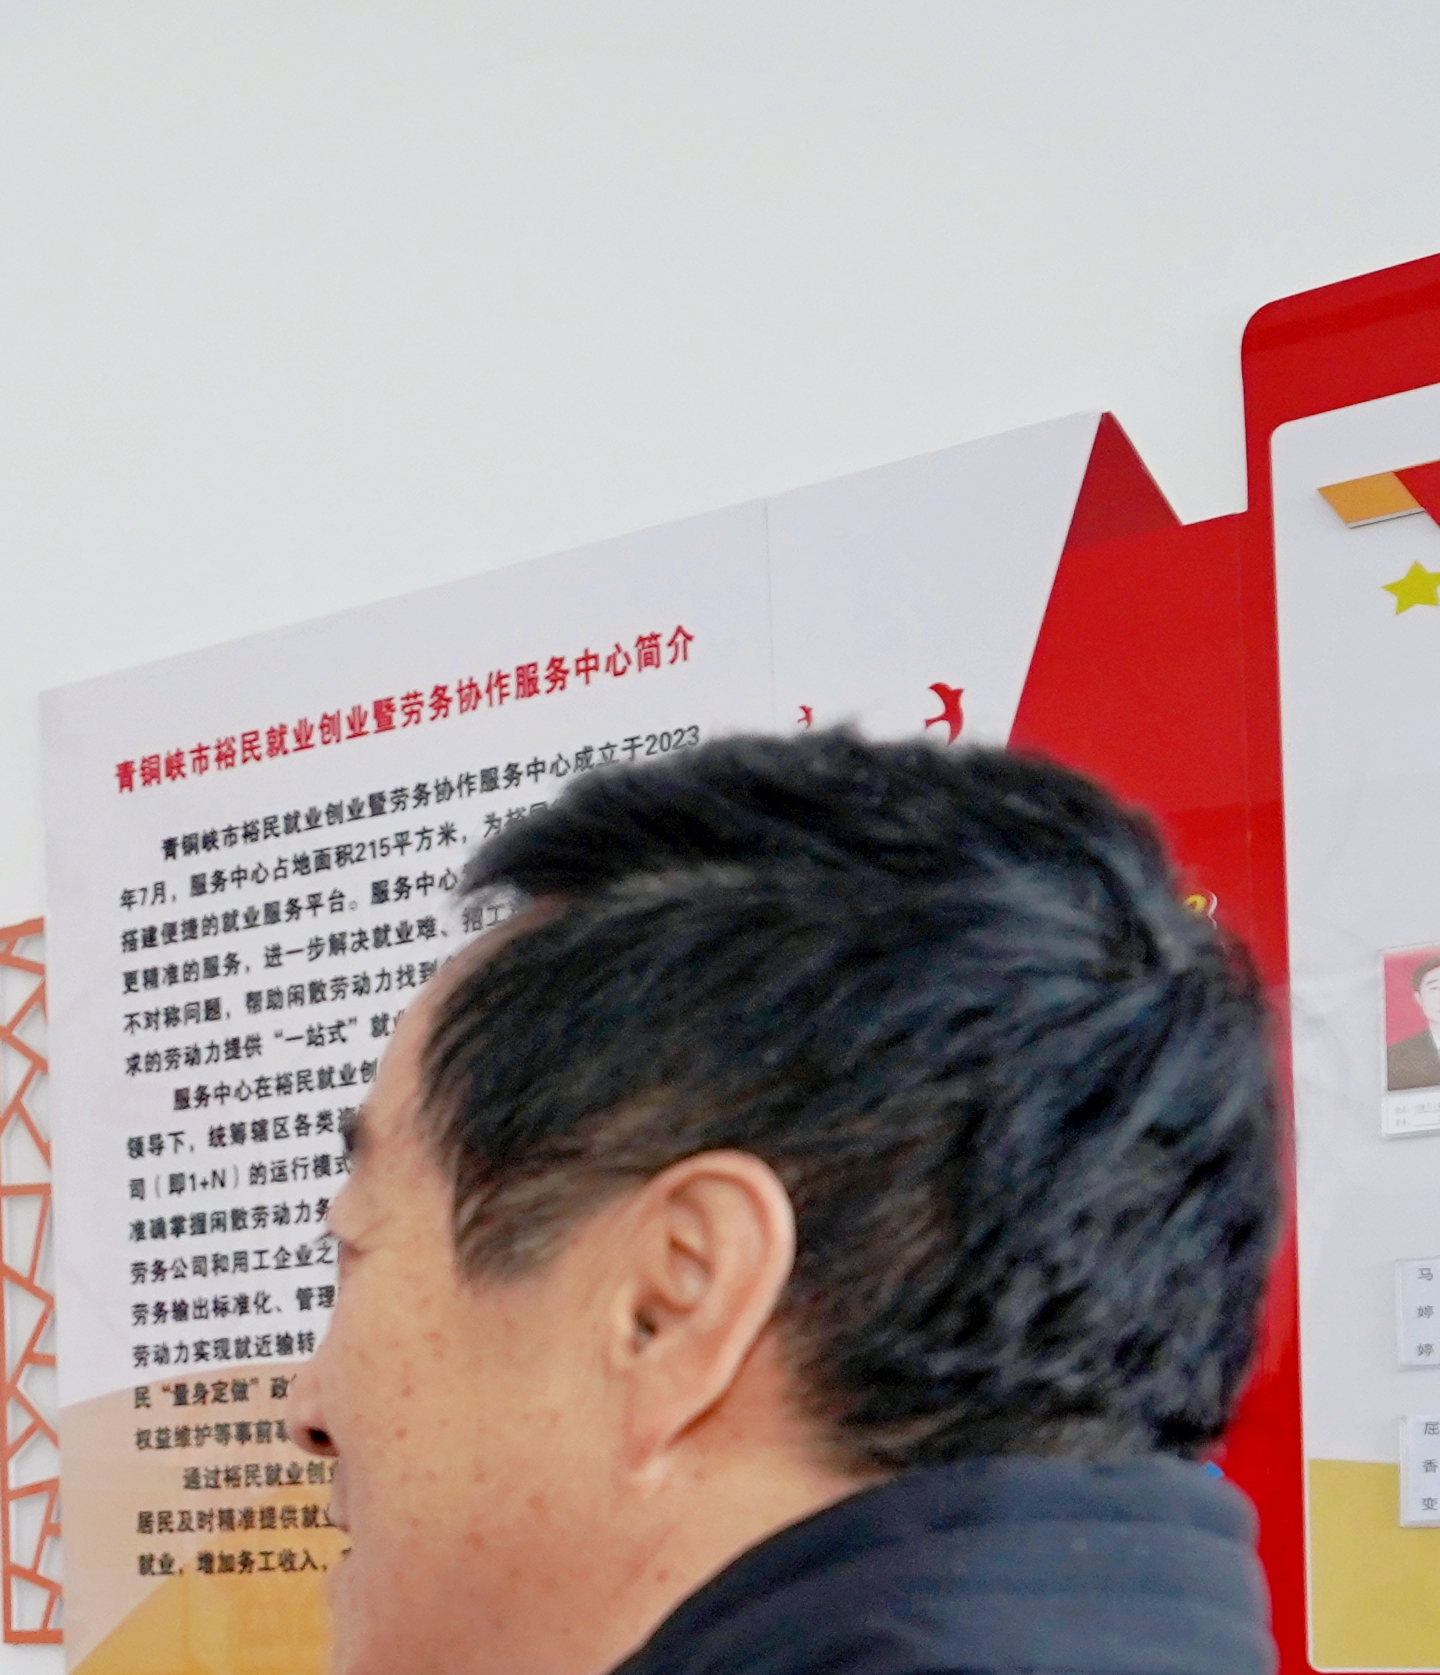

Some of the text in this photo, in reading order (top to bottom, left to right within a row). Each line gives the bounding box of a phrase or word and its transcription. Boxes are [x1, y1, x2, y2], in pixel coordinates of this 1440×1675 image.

[115, 625, 696, 795] 青铜峡市裕民就业创业暨劳务协作服务中心简介
[123, 956, 455, 1036] 不对称问题，帮助闲散劳动力找到
[130, 1240, 342, 1286] 劳务公司和用工企业之
